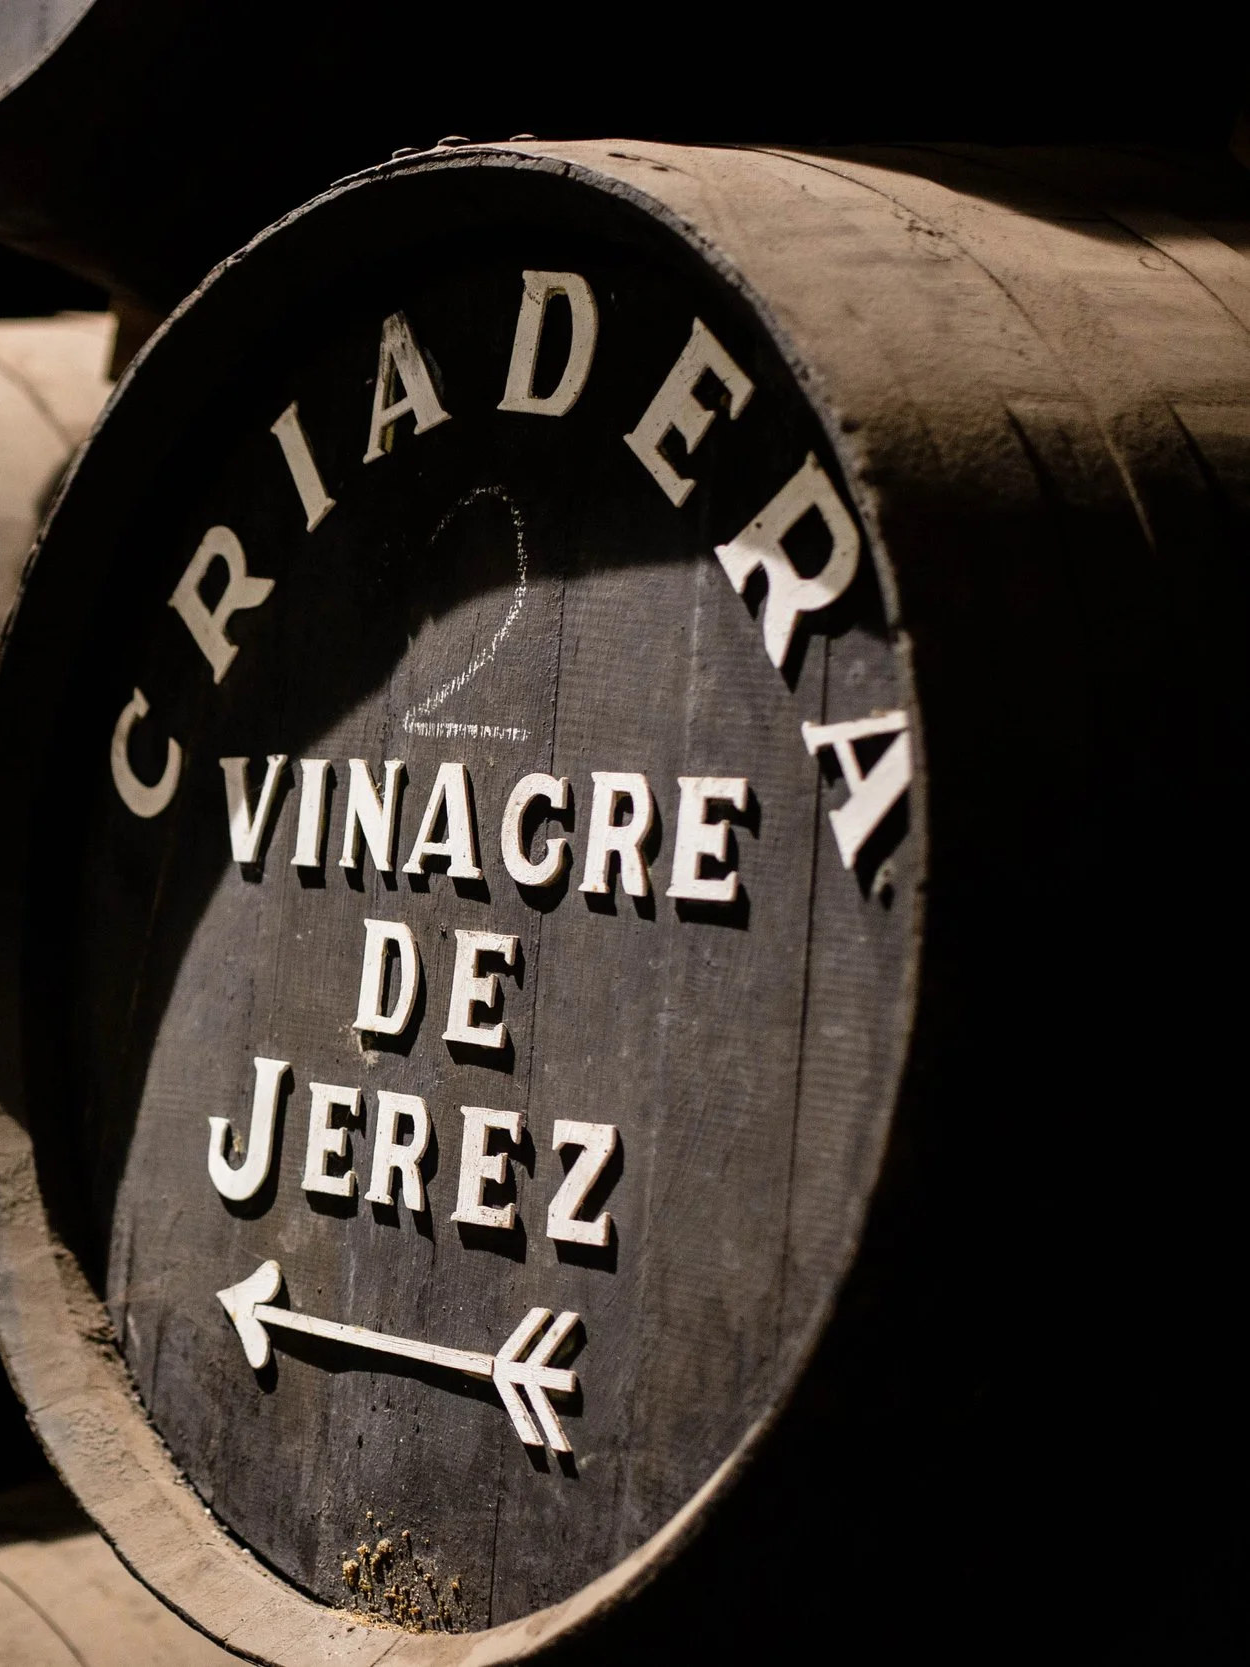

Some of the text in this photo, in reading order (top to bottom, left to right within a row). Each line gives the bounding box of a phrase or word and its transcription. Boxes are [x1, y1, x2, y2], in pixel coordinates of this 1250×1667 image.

[110, 269, 912, 869] CRIADERA
[403, 484, 530, 741] 2
[219, 754, 748, 903] VINAGRE
[353, 919, 520, 1048] DE
[208, 1057, 617, 1247] JEREZ
